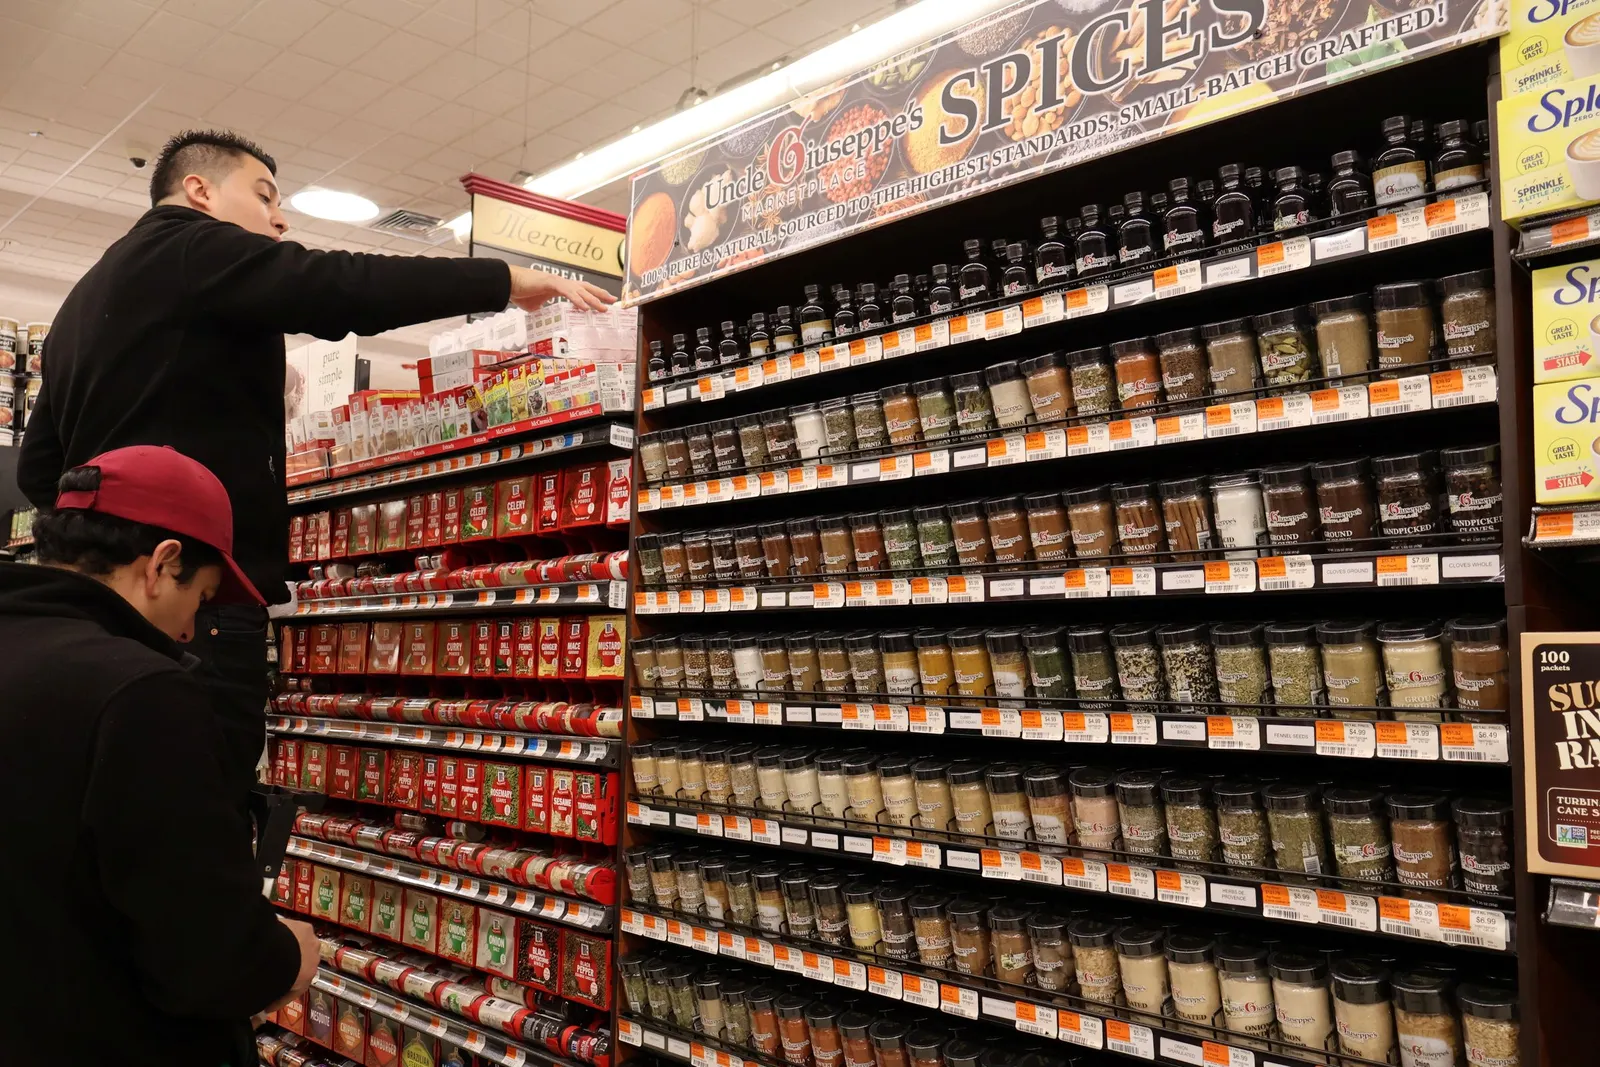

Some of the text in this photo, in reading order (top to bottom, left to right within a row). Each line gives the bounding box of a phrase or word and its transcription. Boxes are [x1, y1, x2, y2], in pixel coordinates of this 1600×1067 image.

[1522, 41, 1543, 54] GREAT
[1524, 47, 1544, 61] TASTE
[938, 0, 1268, 146] SPICES
[1518, 63, 1563, 88] SPRINKLE
[1549, 71, 1563, 83] JOY
[1574, 113, 1594, 122] ZERO
[640, 9, 1446, 288] 100% PURE & NATURAL, SOURCED TO THE HIGHEST STANDARDS, SMALL-BATCH CRAFTED!
[704, 101, 925, 211] Uncle Giuseppe's
[1521, 151, 1543, 165] GREAT
[1523, 158, 1544, 170] TASTE
[741, 162, 866, 221] MARKETPLACE
[1517, 177, 1564, 197] SPRINKLE
[1525, 189, 1550, 202] LITTLE
[1551, 185, 1566, 195] JOY
[1461, 202, 1480, 210] $7.99
[1402, 215, 1419, 224] $8.49
[492, 205, 604, 262] Mercato
[1551, 324, 1572, 335] GREAT
[1552, 330, 1574, 341] TASTE
[323, 350, 340, 367] pure
[1556, 355, 1580, 368] START
[318, 369, 343, 390] simple
[1468, 373, 1487, 382] $4.99
[1404, 383, 1422, 391] $4.99
[323, 390, 336, 406] joy
[1343, 392, 1360, 401] $4.99
[1288, 401, 1303, 409] $9.99
[570, 408, 593, 418] McCormick
[1233, 407, 1251, 416] $11.99
[531, 418, 552, 426] McCormick
[1134, 422, 1148, 430] $5.49
[1183, 417, 1198, 425] $4.99
[496, 426, 516, 434] McCormick
[1552, 444, 1574, 454] GREAT
[1554, 450, 1575, 460] TASTE
[1557, 476, 1582, 488] START
[578, 489, 593, 499] CHILI
[611, 490, 628, 498] TARTAR
[470, 506, 487, 516] CELERY
[507, 501, 525, 511] CELERY
[358, 525, 368, 533] BASIL
[389, 521, 397, 529] BAY
[1039, 549, 1064, 557] SAIGON
[447, 643, 462, 651] CURRY
[568, 642, 580, 650] MACE
[599, 642, 621, 650] MUSTARD
[1540, 651, 1570, 664] 100
[1540, 664, 1570, 672] packets
[1391, 674, 1409, 683] Uncle
[365, 771, 380, 779] PARSLEY
[399, 776, 411, 785] PEPPER
[491, 788, 512, 798] ROSEMARY
[532, 794, 543, 803] SAGE
[554, 797, 571, 806] SESAME
[1556, 796, 1600, 807] TURBIN
[1556, 806, 1589, 816] CANE
[1464, 878, 1498, 892] JUNIPER
[319, 887, 333, 898] GARLIC
[1350, 899, 1368, 907] $5.99
[380, 905, 395, 916] GARLIC
[1415, 908, 1433, 917] $6.99
[414, 915, 429, 926] ONION
[1476, 916, 1496, 925] $6.99
[449, 924, 466, 937] ONIONS
[488, 933, 505, 947] ONION
[532, 946, 546, 957] BLACK
[579, 960, 591, 968] BLACK
[576, 965, 594, 977] PEPPER
[1133, 1029, 1147, 1037] $5.99
[370, 1034, 397, 1055] HAMBURGER
[1167, 1047, 1196, 1059] GRANULATED
